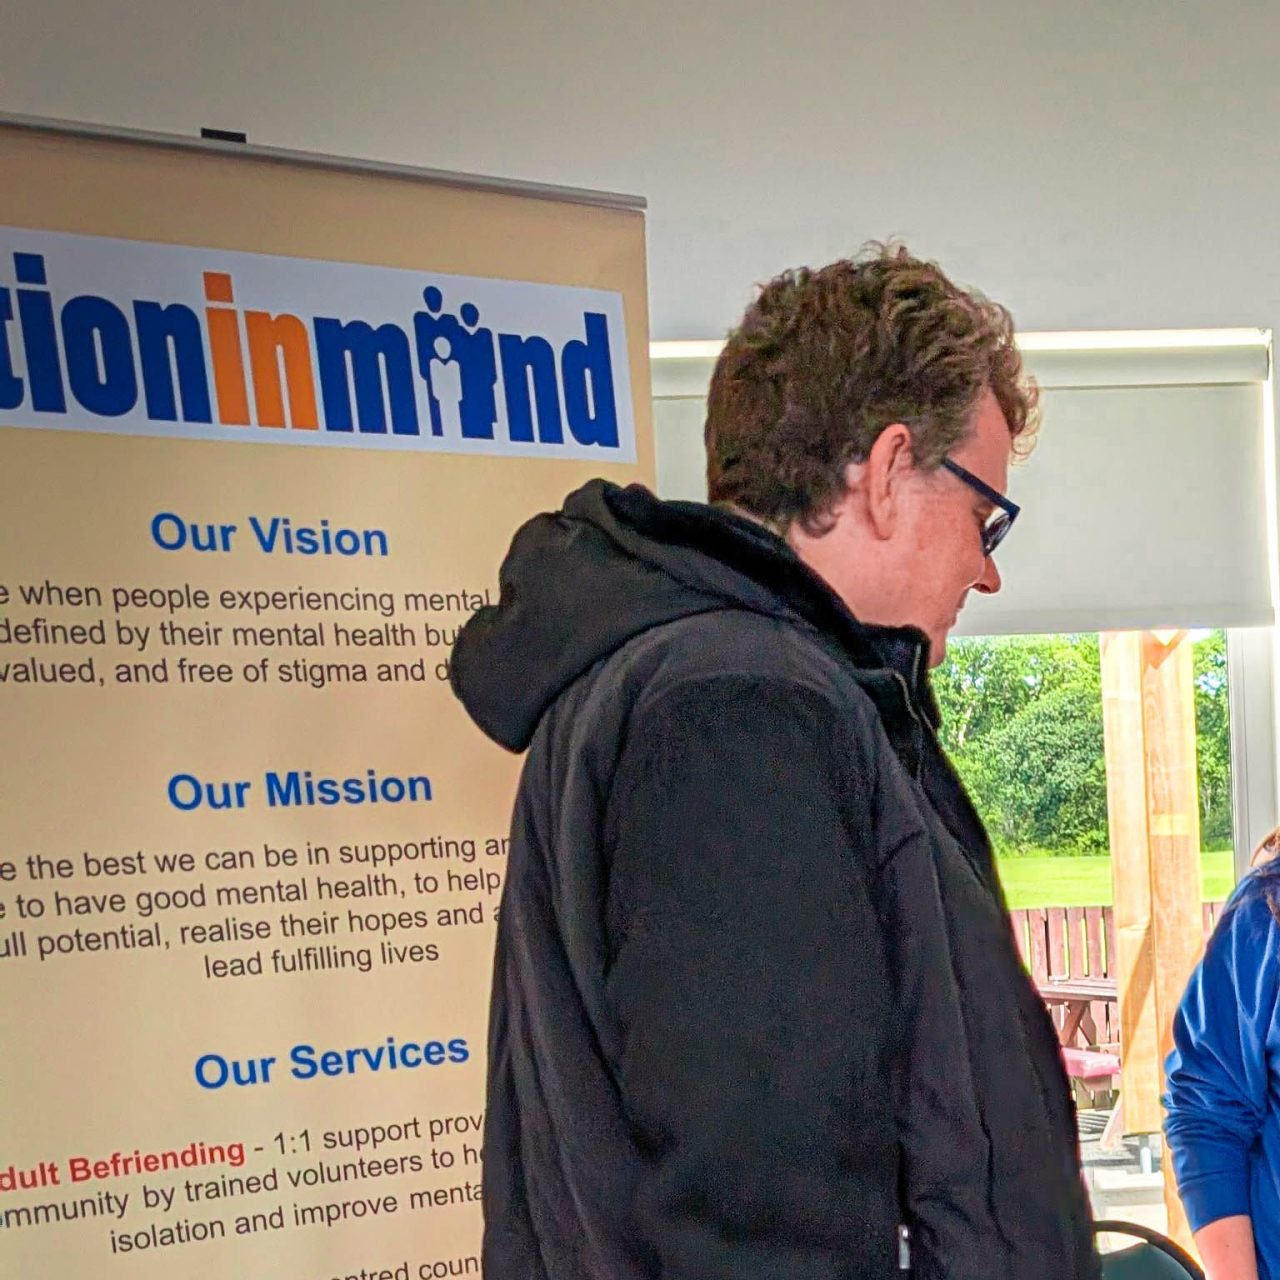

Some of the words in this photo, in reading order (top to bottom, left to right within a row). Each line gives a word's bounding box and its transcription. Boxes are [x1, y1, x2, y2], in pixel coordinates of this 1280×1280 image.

[151, 512, 237, 552] Our
[248, 516, 388, 556] Vision
[19, 580, 102, 606] when
[112, 583, 209, 614] people
[220, 586, 394, 617] experiencing
[405, 588, 490, 612] mental
[116, 620, 150, 652] by
[159, 621, 222, 646] their
[233, 622, 324, 646] mental
[334, 622, 416, 646] health
[115, 658, 168, 683] and
[177, 658, 233, 683] free
[243, 658, 269, 682] of
[278, 658, 367, 688] stigma
[377, 658, 425, 681] and
[168, 774, 251, 810] Our
[265, 769, 432, 806] Mission
[26, 855, 73, 880] the
[84, 851, 147, 877] best
[154, 854, 195, 873] we
[205, 851, 254, 870] can
[264, 844, 298, 867] be
[307, 842, 329, 865] in
[340, 836, 475, 868] supporting
[15, 894, 45, 918] to
[55, 891, 126, 916] have
[136, 883, 206, 917] good
[216, 877, 307, 906] mental
[317, 873, 405, 900] health,
[414, 873, 438, 894] to
[447, 868, 501, 895] help
[38, 922, 169, 961] potential,
[180, 917, 271, 944] realise
[280, 911, 339, 937] their
[348, 910, 428, 936] hopes
[437, 902, 484, 926] and
[205, 951, 262, 978] lead
[271, 945, 372, 973] fulfilling
[381, 943, 439, 964] lives
[194, 1053, 276, 1089] Our
[290, 1037, 470, 1080] Services
[0, 1162, 60, 1191] dult
[69, 1143, 244, 1182] Befriending
[274, 1129, 310, 1155] 1:1
[323, 1117, 421, 1151] support
[143, 1185, 175, 1212] by
[184, 1168, 278, 1202] trained
[287, 1155, 423, 1187] volunteers
[431, 1148, 454, 1169] to
[110, 1219, 225, 1253] isolation
[235, 1205, 284, 1234] and
[293, 1196, 397, 1227] improve
